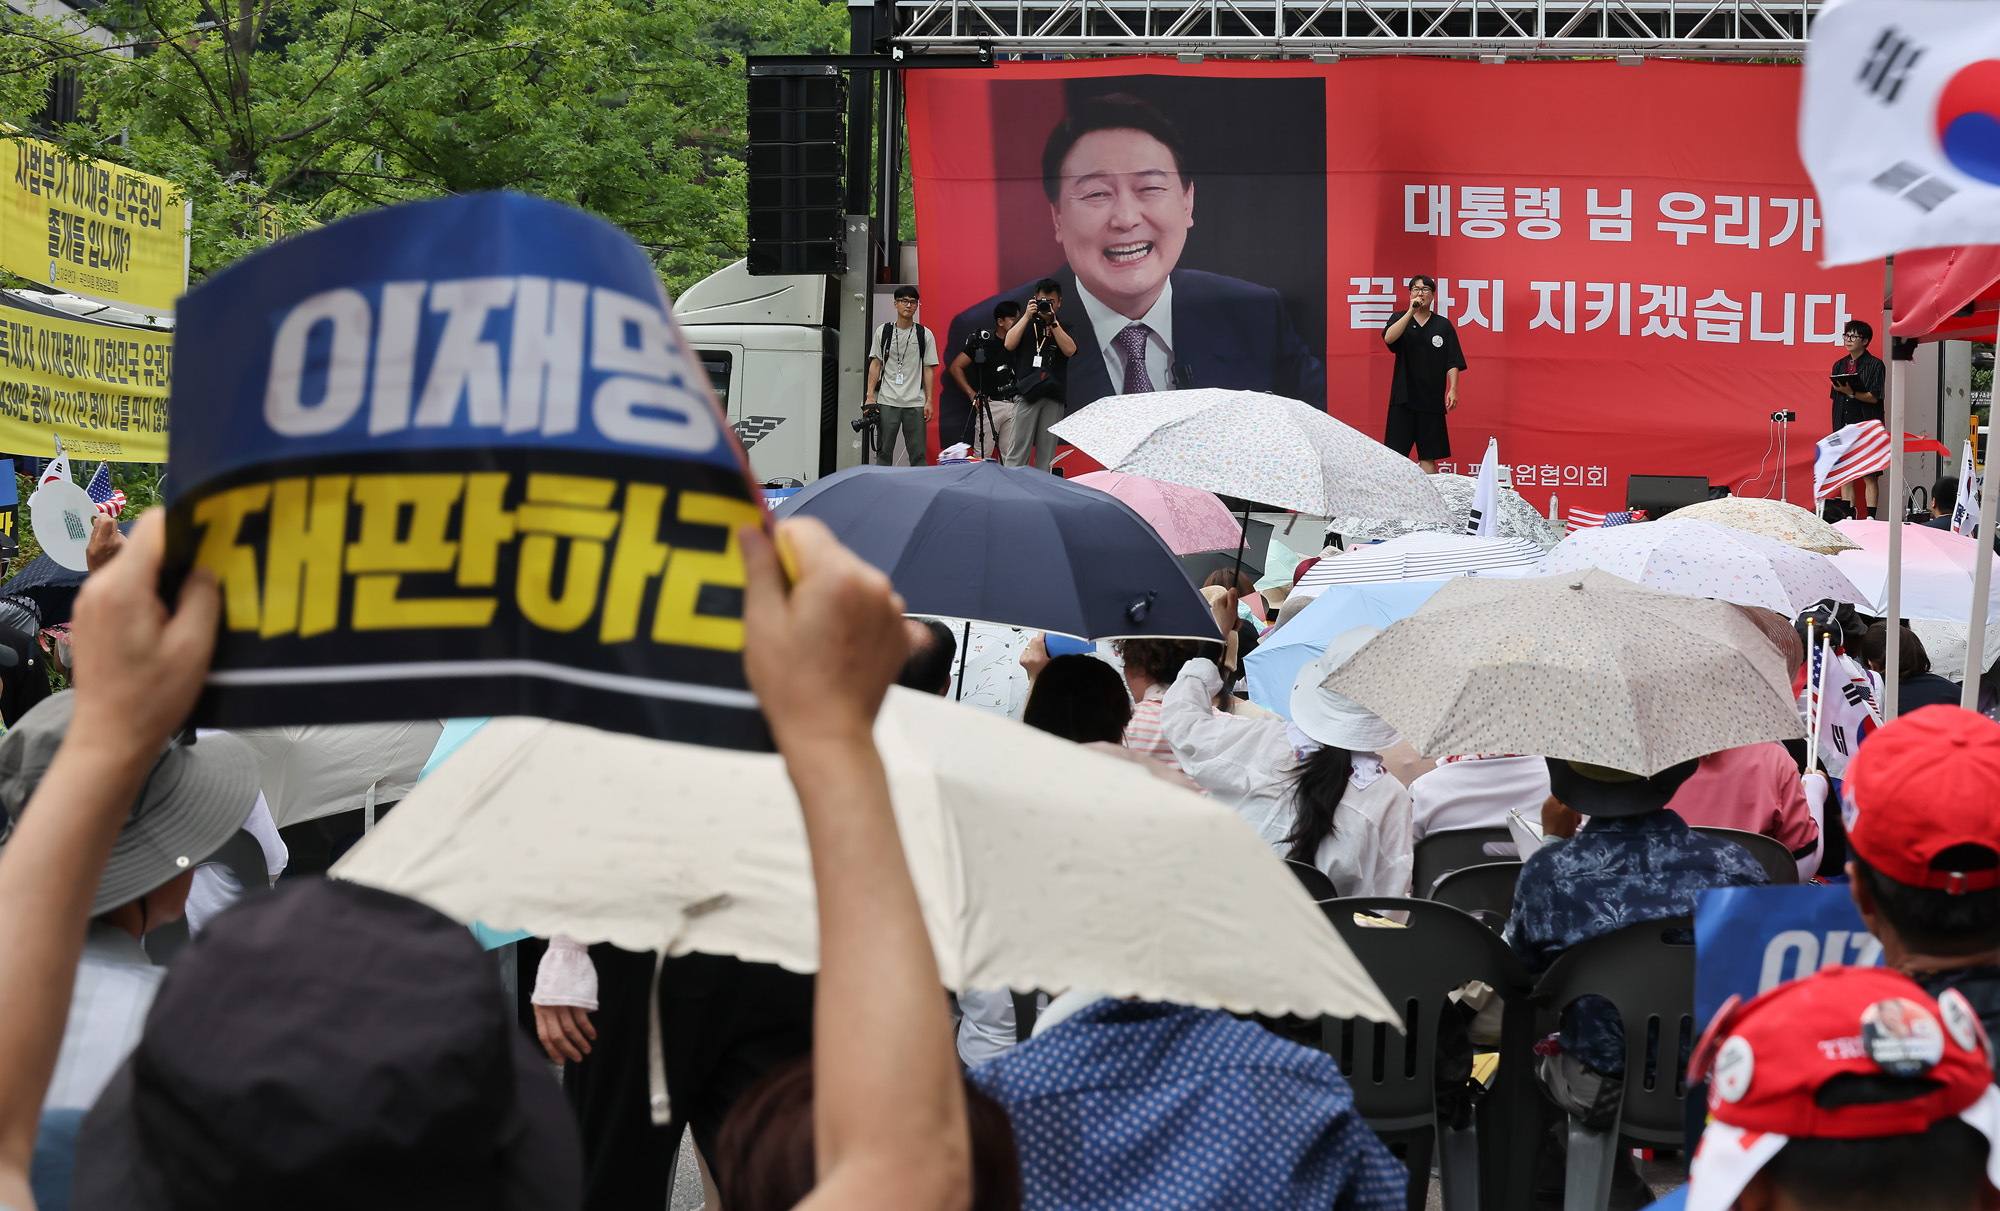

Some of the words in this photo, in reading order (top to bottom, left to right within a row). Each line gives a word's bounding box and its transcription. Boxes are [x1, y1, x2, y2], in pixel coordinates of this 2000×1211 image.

[15, 142, 69, 204] 사법부가
[48, 208, 86, 265] 졸개들
[88, 219, 131, 274] 입니까?
[1404, 184, 1561, 240] 대통령
[1586, 188, 1633, 242] 님
[1657, 191, 1821, 252] 우리가
[1529, 280, 1852, 346] 지키겠습니다
[38, 328, 91, 379] 이재명아!
[94, 338, 139, 386] 대한민국
[31, 385, 51, 425] 중에
[54, 391, 88, 428] 2711만
[89, 393, 108, 430] 명이
[111, 395, 129, 432] 너를
[131, 396, 152, 432] 찍지
[1468, 463, 1608, 487] 원협의회
